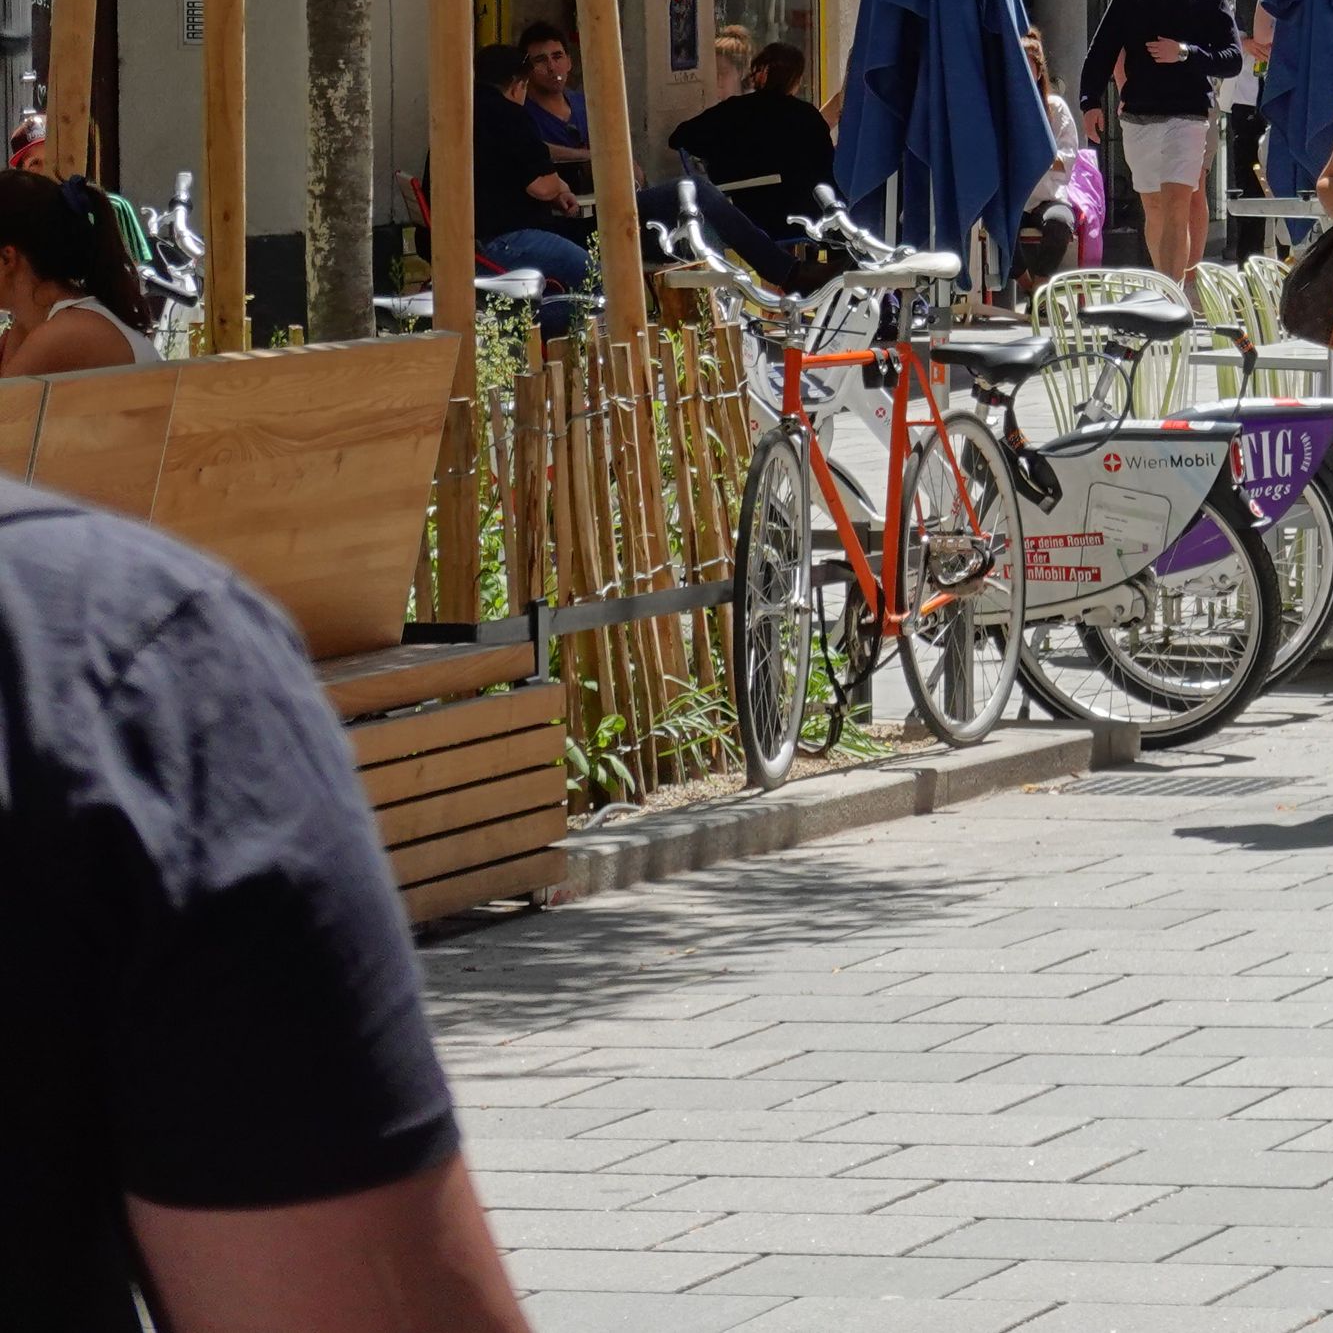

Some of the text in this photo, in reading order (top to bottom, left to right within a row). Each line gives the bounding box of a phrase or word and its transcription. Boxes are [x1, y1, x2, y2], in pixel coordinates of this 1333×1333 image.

[1125, 452, 1217, 470] WienMobil
[1038, 537, 1064, 549] deine
[1066, 534, 1101, 546] Routen
[1033, 553, 1048, 563] der
